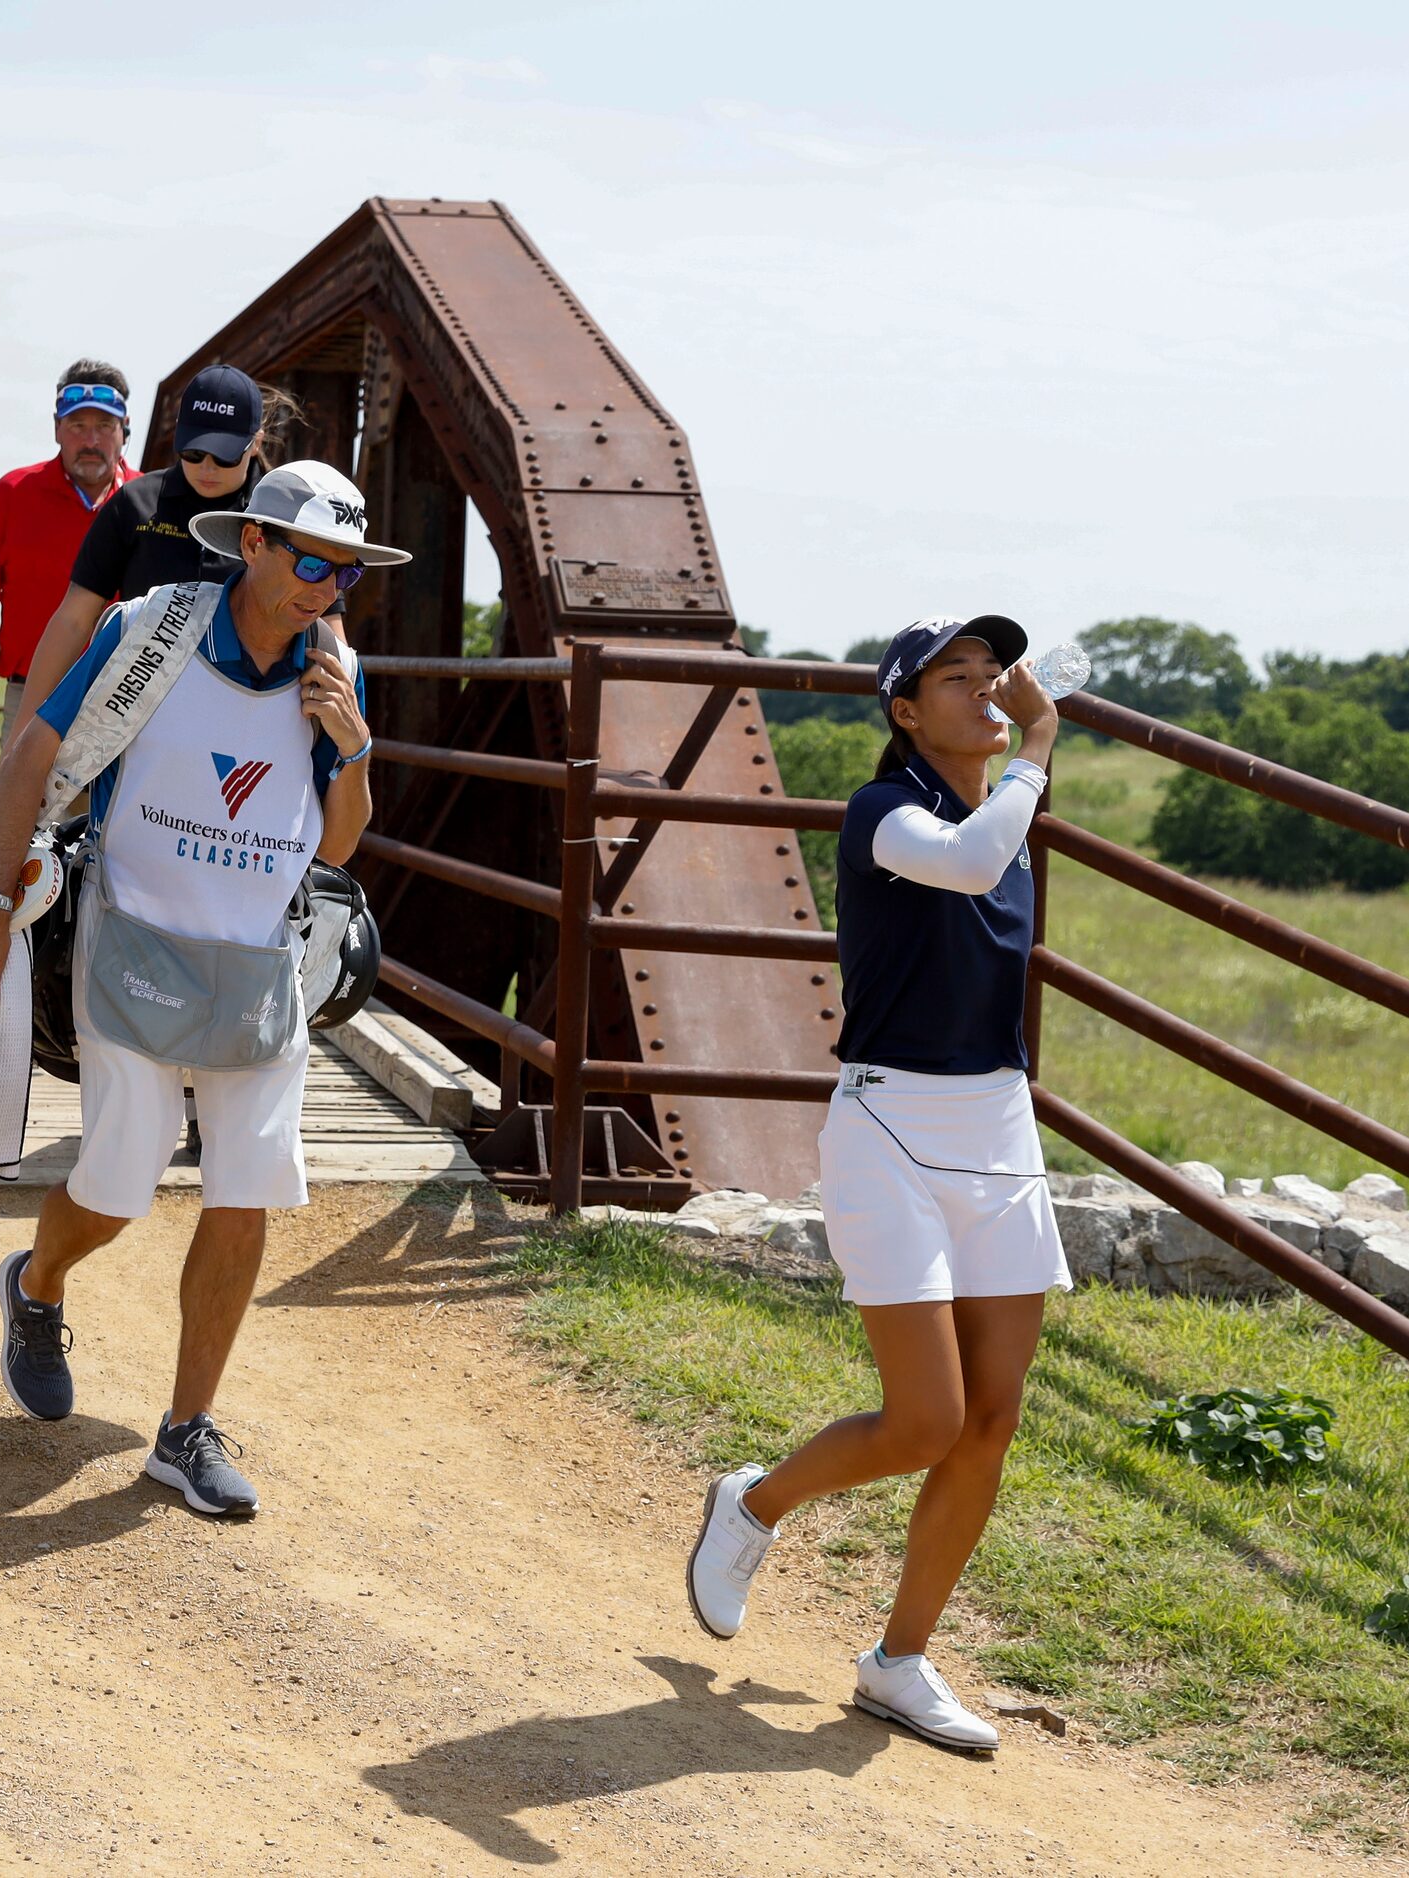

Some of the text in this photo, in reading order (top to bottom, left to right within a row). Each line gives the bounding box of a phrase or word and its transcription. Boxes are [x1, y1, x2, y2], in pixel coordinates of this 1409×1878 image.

[193, 401, 235, 416] POLICE
[105, 646, 165, 718] PARSONS
[150, 589, 197, 651] XTREME
[880, 656, 903, 696] PXG
[140, 804, 227, 841] Volunteers
[231, 829, 251, 845] of
[128, 976, 152, 989] RACE
[138, 990, 183, 1009] CME GLOBE
